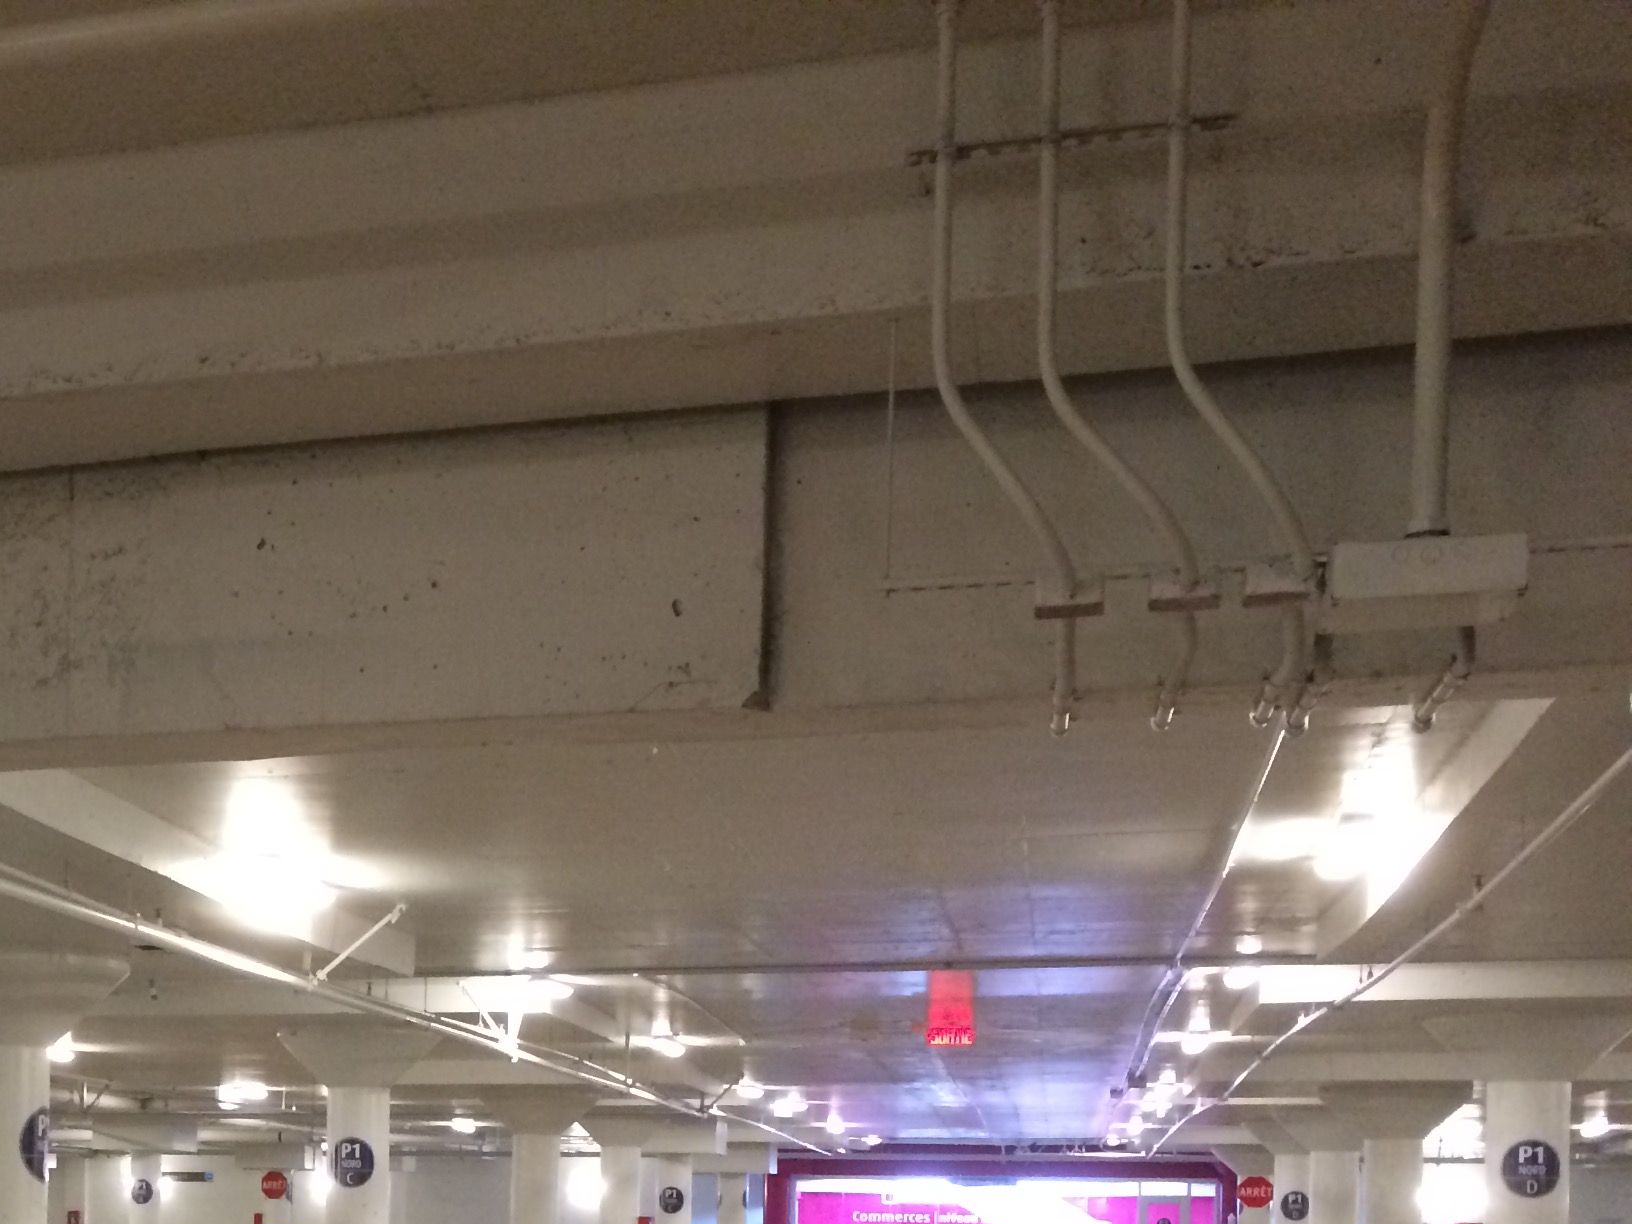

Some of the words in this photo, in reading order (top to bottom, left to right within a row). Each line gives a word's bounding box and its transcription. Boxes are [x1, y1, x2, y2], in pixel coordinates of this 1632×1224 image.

[342, 1143, 360, 1159] P1
[1519, 1146, 1544, 1164] P1
[347, 1172, 354, 1184] C
[1240, 1186, 1272, 1197] ARRÊT
[1527, 1180, 1538, 1194] D
[666, 1190, 677, 1198] P1
[1289, 1194, 1302, 1204] P1
[852, 1211, 931, 1223] Commerces
